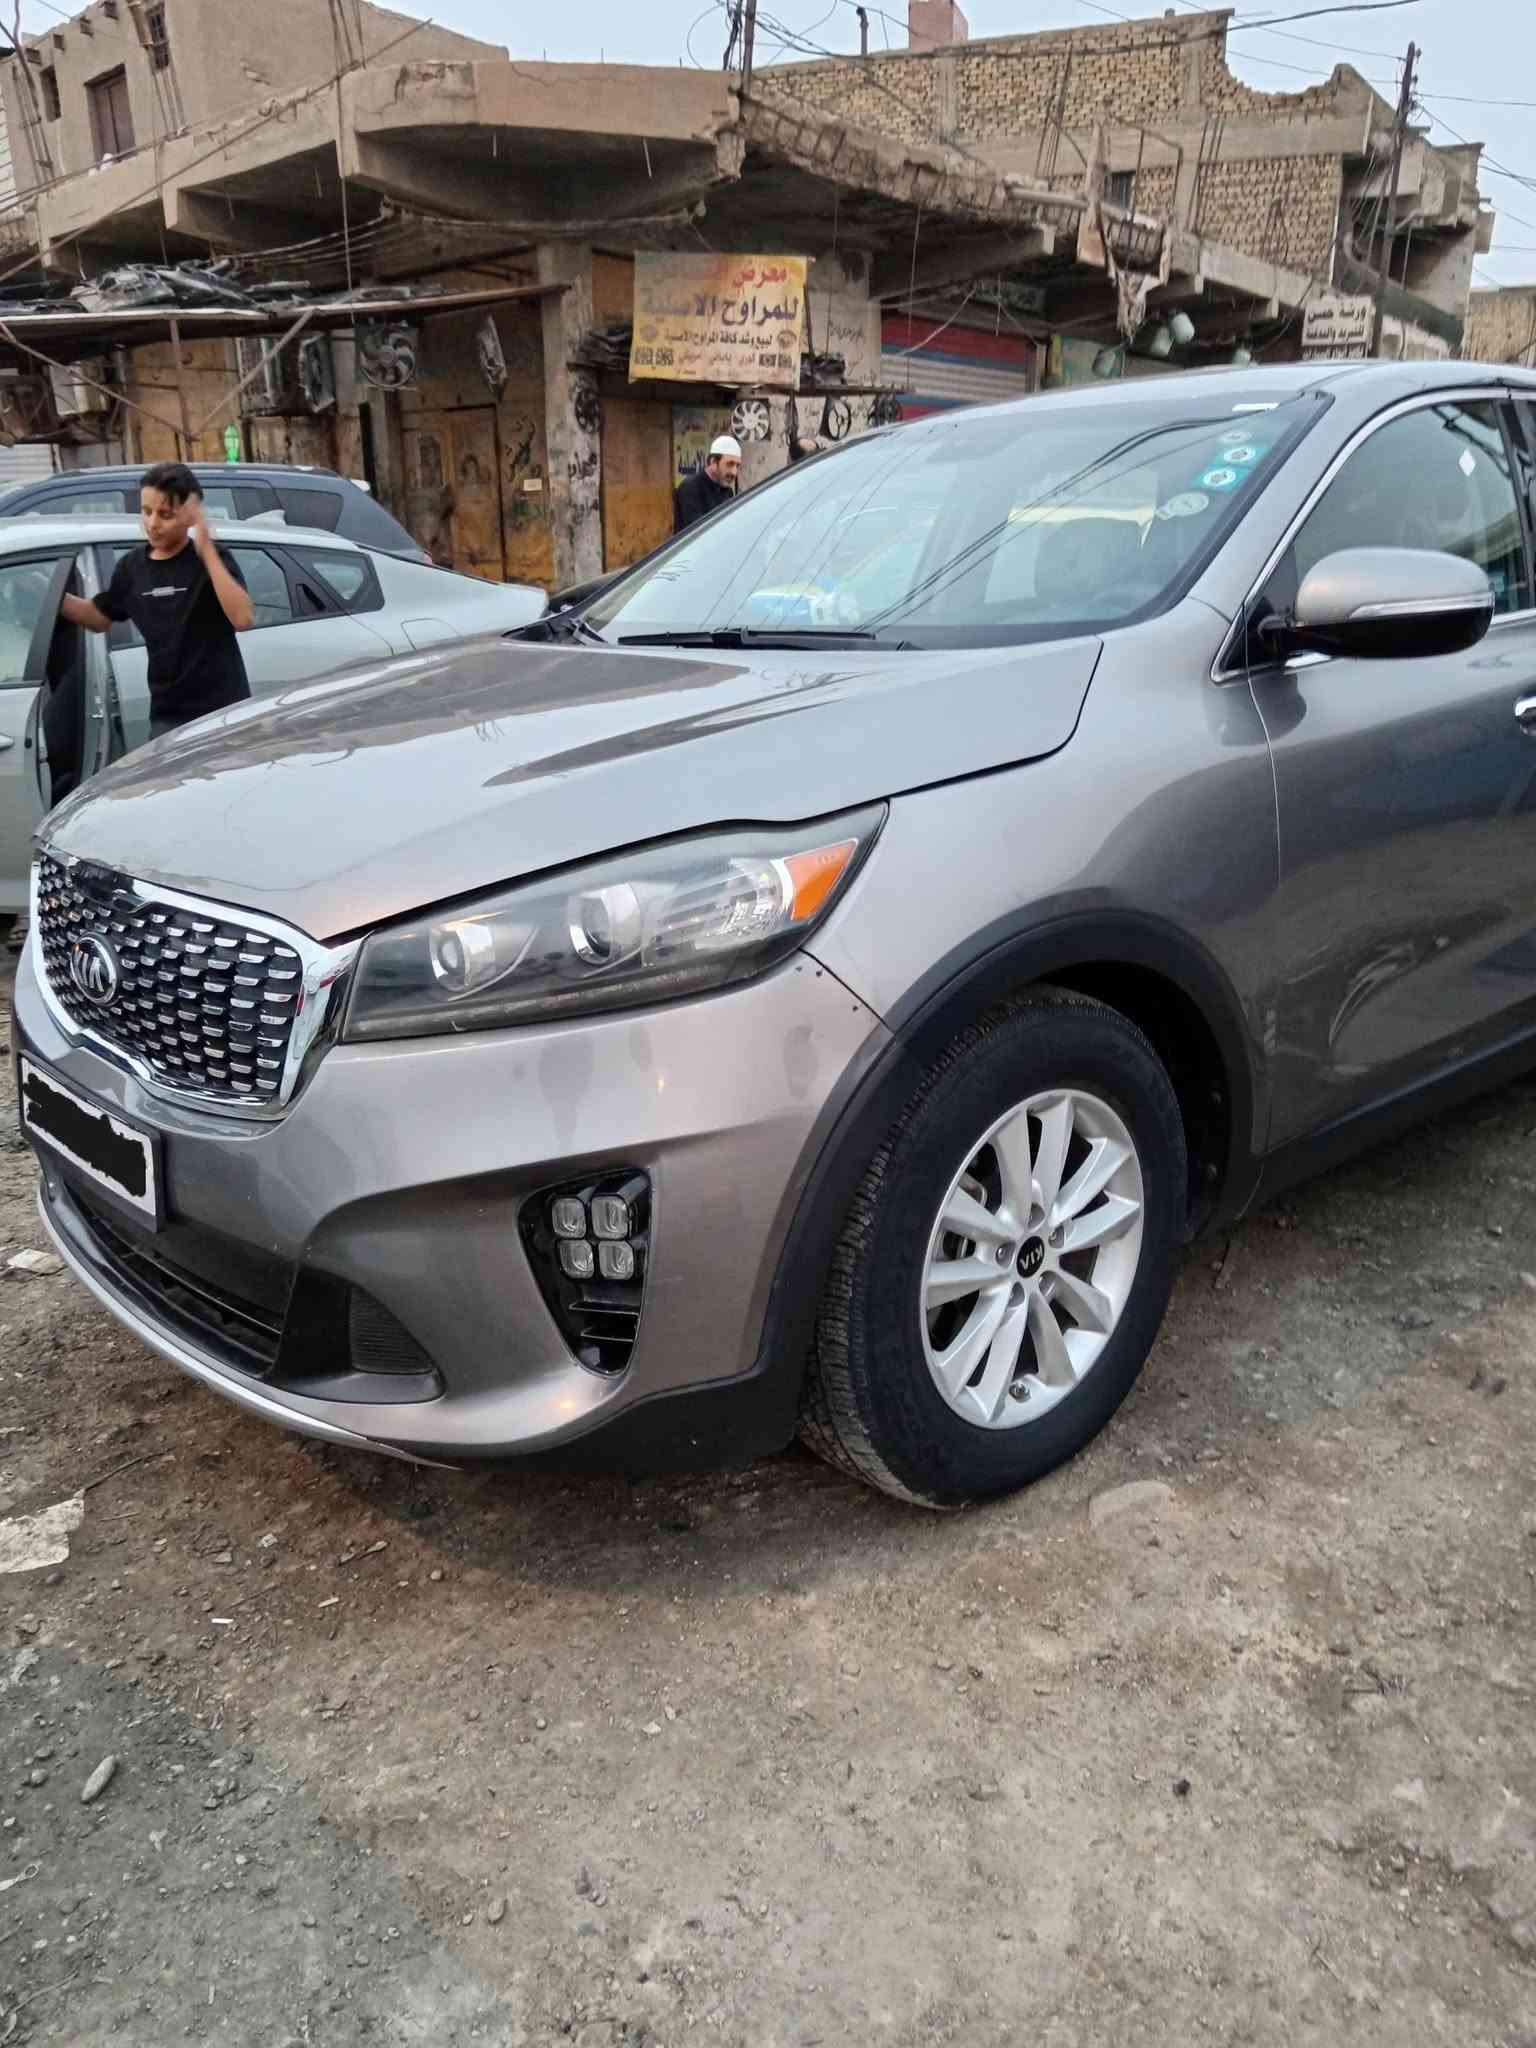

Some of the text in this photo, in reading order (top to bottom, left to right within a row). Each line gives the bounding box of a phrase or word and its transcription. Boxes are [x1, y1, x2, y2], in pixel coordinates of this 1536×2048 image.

[733, 262, 787, 289] معرض
[721, 296, 799, 326] للمراوح
[754, 334, 773, 350] لبيع
[1020, 1244, 1044, 1270] KIA
